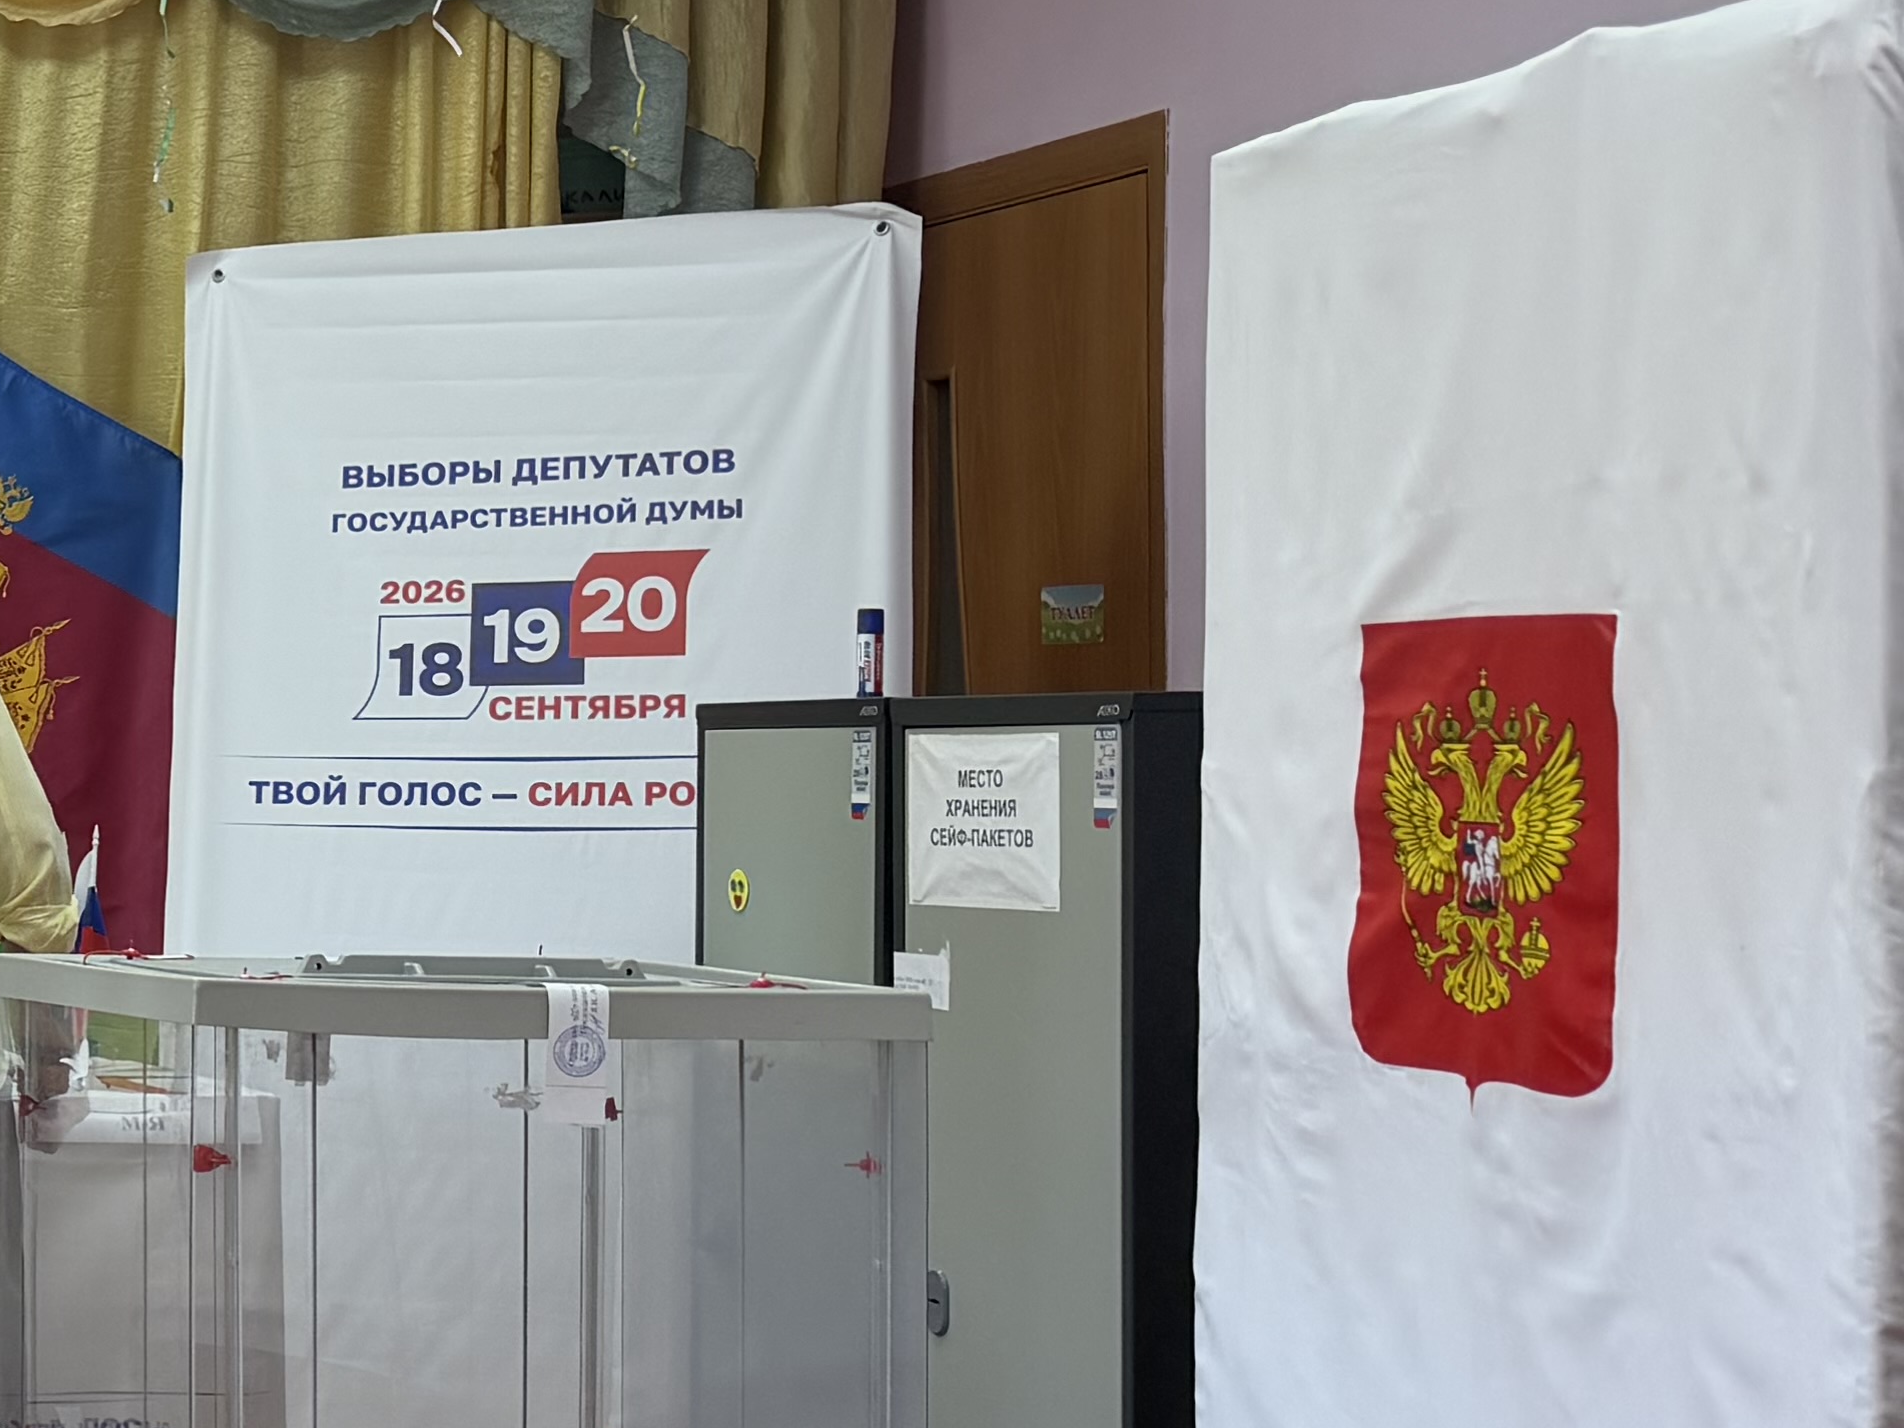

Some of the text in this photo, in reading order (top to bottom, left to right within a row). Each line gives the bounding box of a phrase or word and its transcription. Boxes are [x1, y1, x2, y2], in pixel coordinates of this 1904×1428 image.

[341, 448, 736, 489] ВЫБОРЫ ДЕПУТАТОВ
[331, 497, 743, 534] ГОСУДАРСТВЕННОЙ ДУМЫ
[380, 579, 466, 605] 2026
[389, 575, 677, 697] 18 19 20
[488, 693, 687, 721] СЕНТЯБРЯ
[249, 775, 346, 806] ТВОЙ
[359, 780, 482, 807] ГОЛОС
[528, 781, 633, 807] СИЛА
[958, 769, 1003, 788] МЕСТО
[945, 799, 1017, 817] ХРАНЕНИЯ
[930, 825, 1034, 848] СЕЙФ-ПАКЕТОВ
